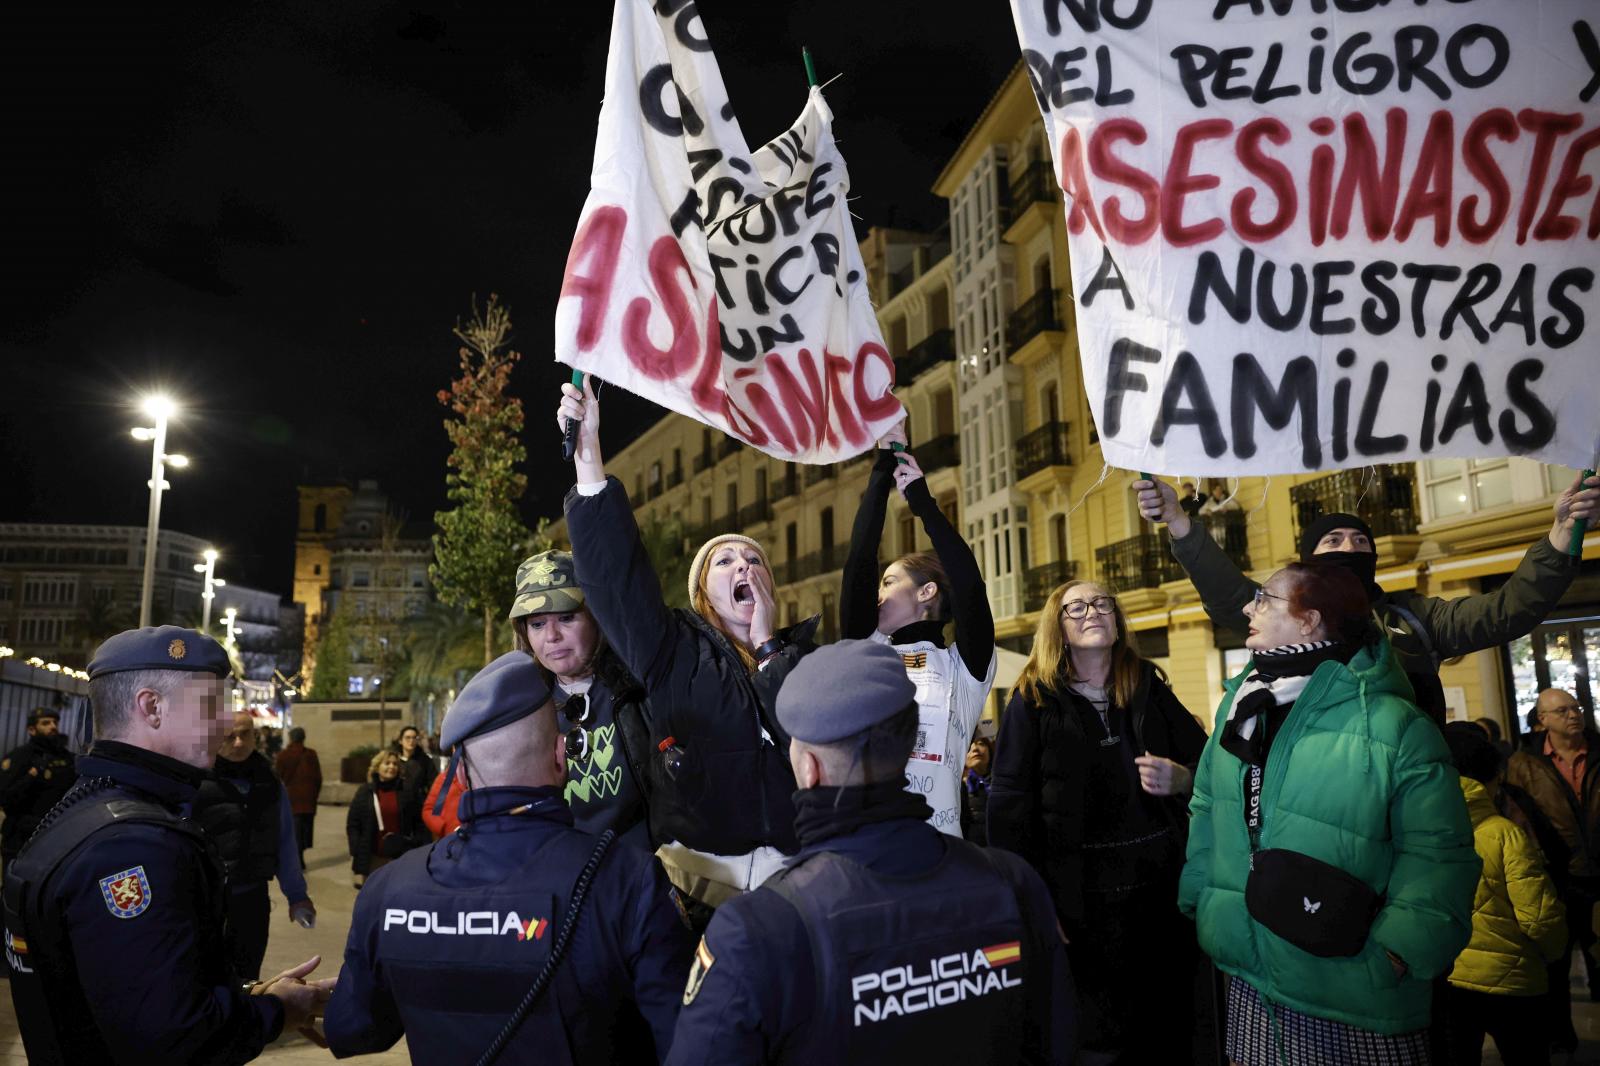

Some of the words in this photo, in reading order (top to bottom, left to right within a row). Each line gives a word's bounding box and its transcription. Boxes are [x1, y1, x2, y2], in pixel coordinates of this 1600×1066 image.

[1023, 45, 1135, 113] DEL
[1081, 245, 1134, 310] A
[1188, 248, 1594, 349] NUESTRAS
[384, 908, 525, 935] POLICIA
[852, 949, 991, 1001] POLICIA
[854, 968, 1022, 1027] NACIONAL
